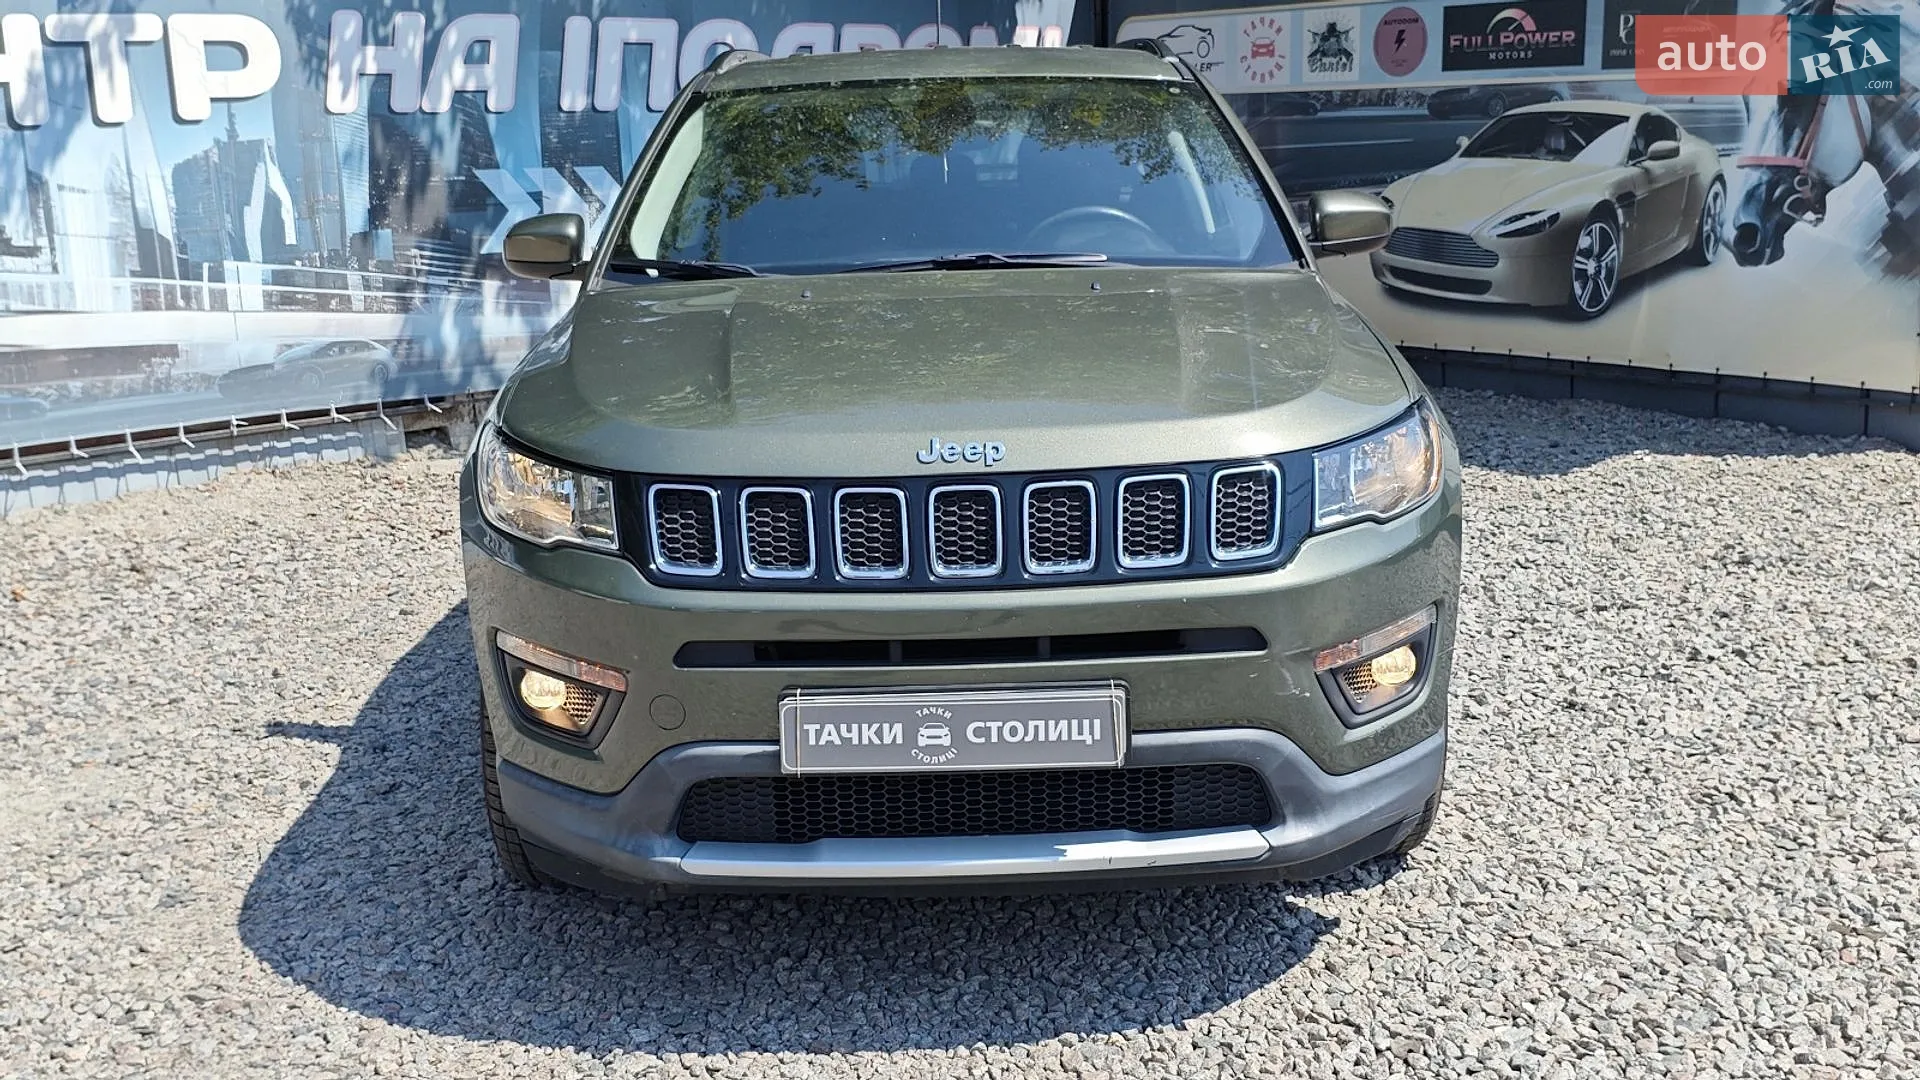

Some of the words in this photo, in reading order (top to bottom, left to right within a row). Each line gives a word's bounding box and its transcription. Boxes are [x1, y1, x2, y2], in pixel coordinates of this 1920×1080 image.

[325, 9, 520, 114] НА
[1488, 50, 1533, 60] MOTORS
[916, 436, 1006, 467] Jeep
[915, 706, 953, 720] ТАЧКИ
[803, 722, 904, 746] ТАЧКИ
[965, 718, 1101, 744] СТОЛИЦІ
[911, 747, 958, 764] СТОЛИЦІ
